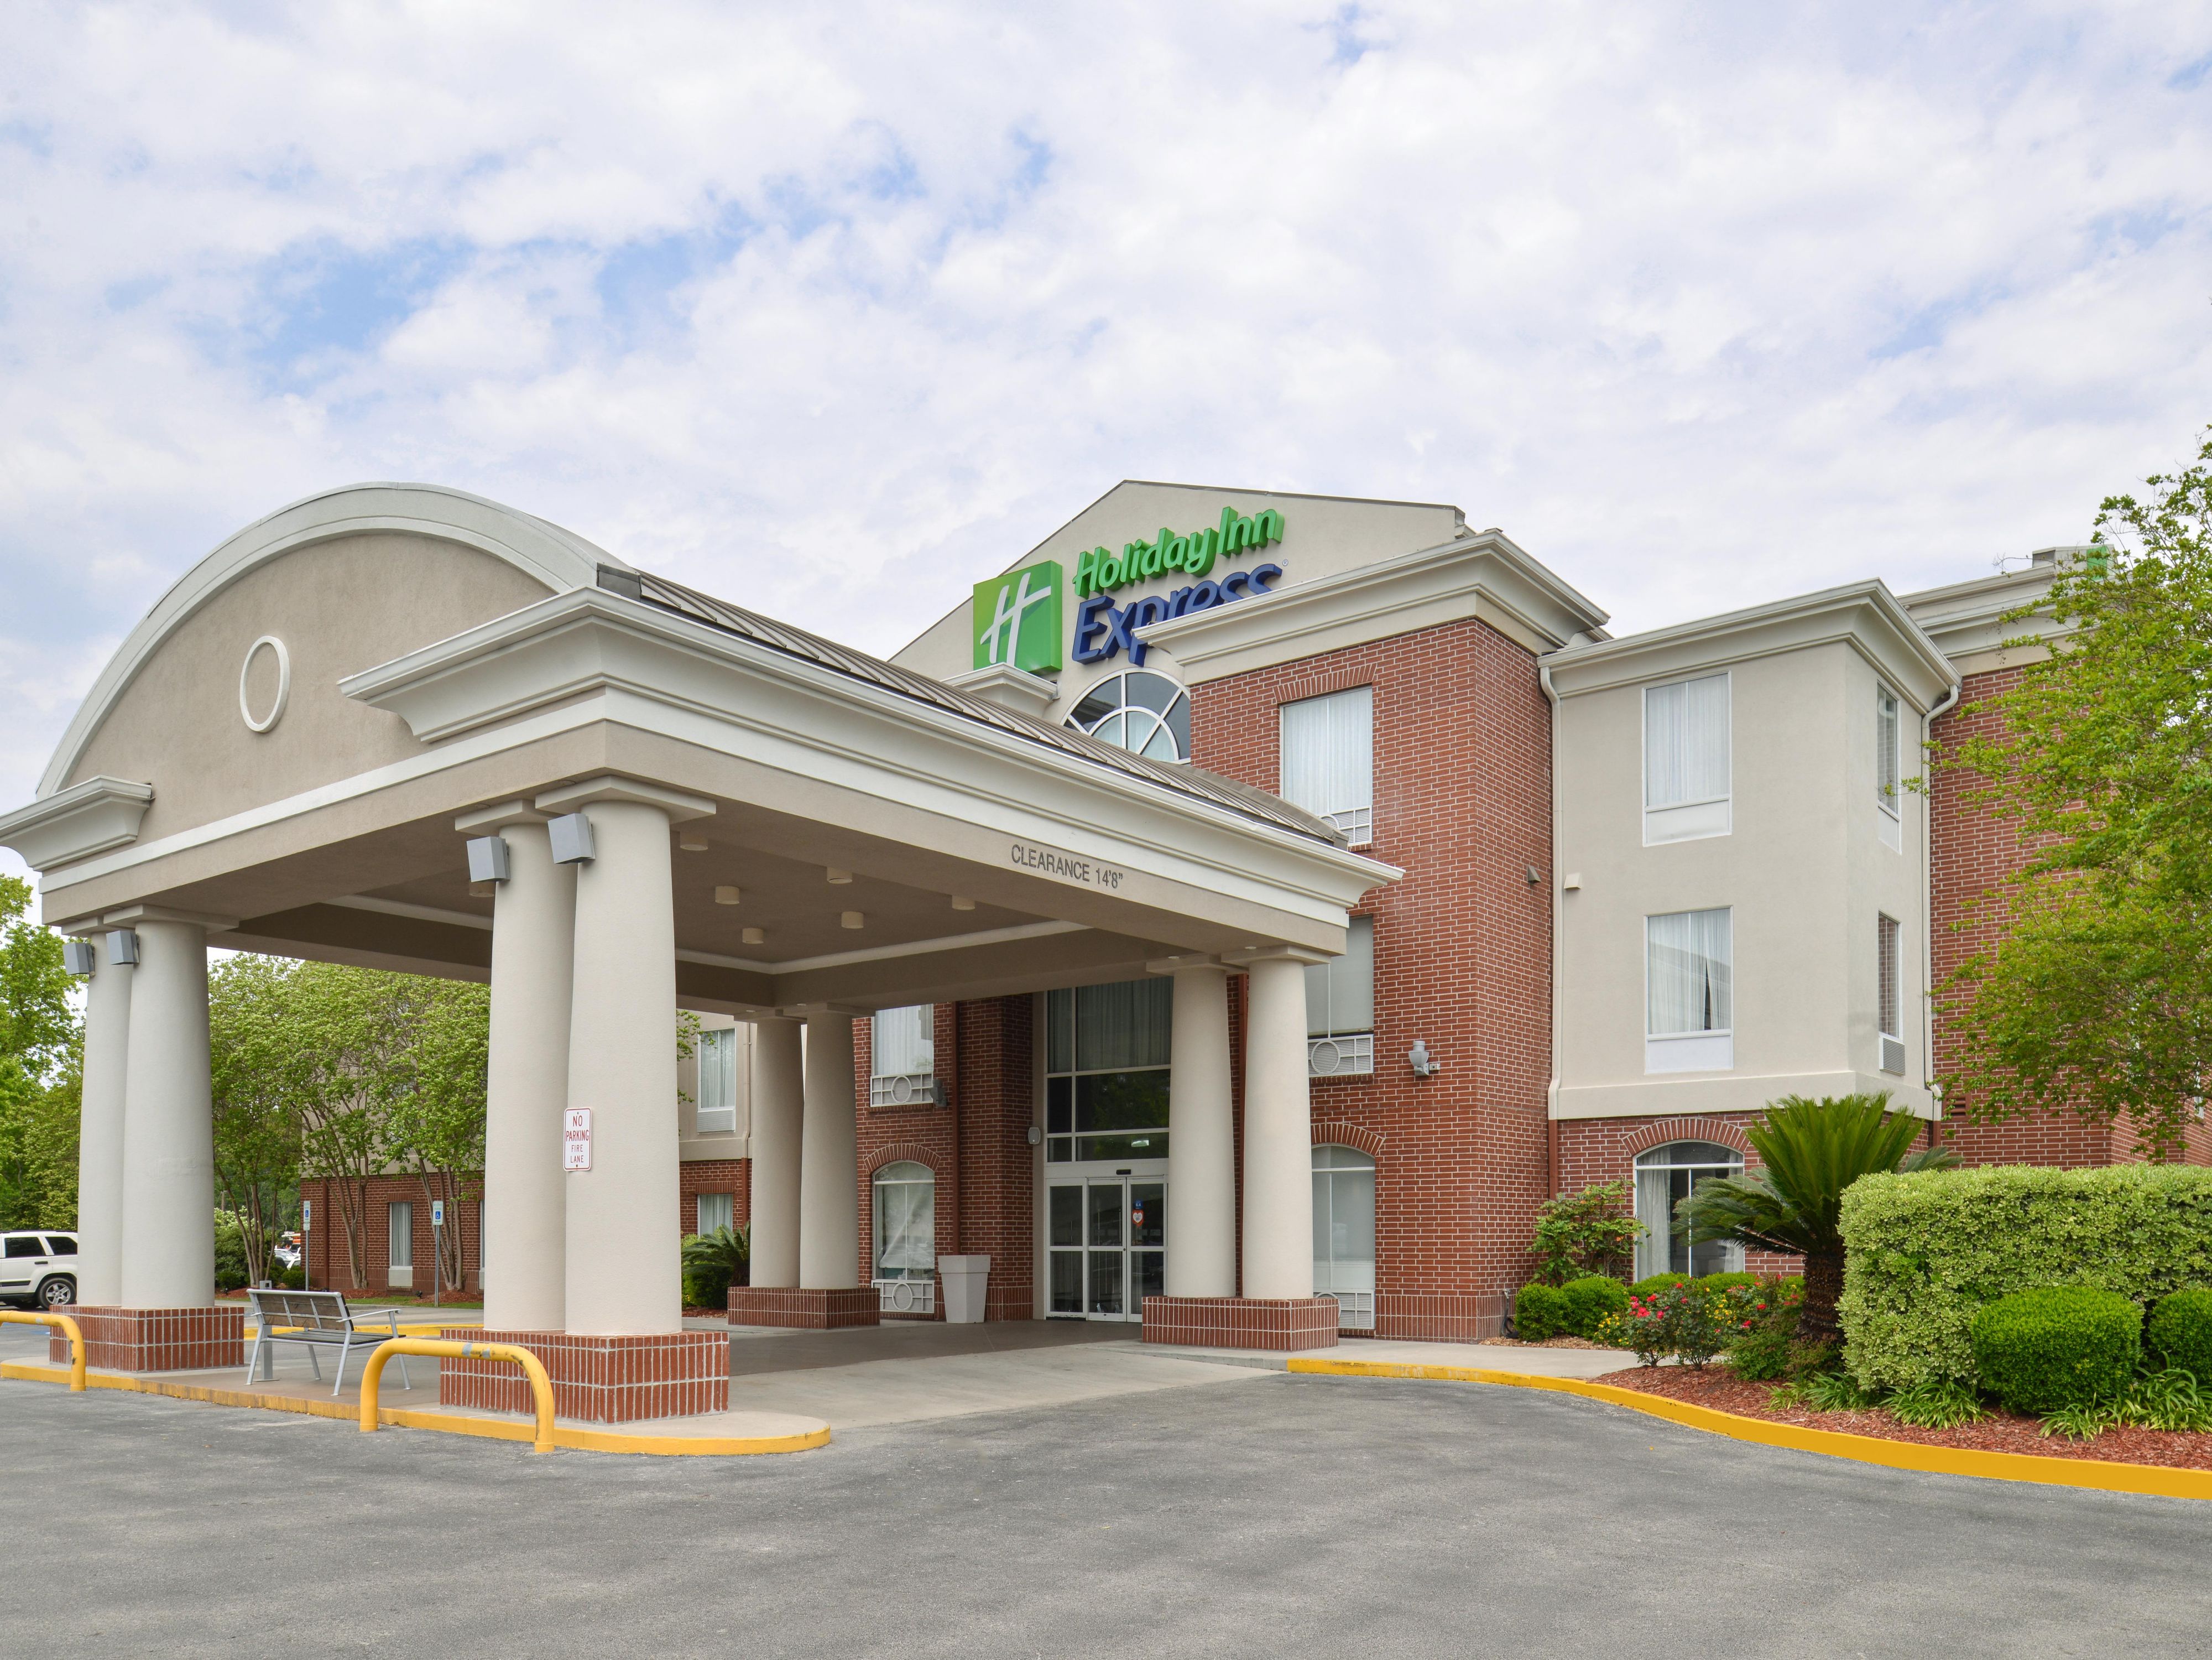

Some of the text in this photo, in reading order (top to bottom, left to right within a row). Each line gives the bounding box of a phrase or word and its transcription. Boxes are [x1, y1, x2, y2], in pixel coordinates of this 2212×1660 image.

[1072, 507, 1285, 599] Holiday Inn
[1011, 844, 1089, 882] CLEARANCE
[573, 1115, 583, 1127] NO
[566, 1130, 589, 1142] PARKING
